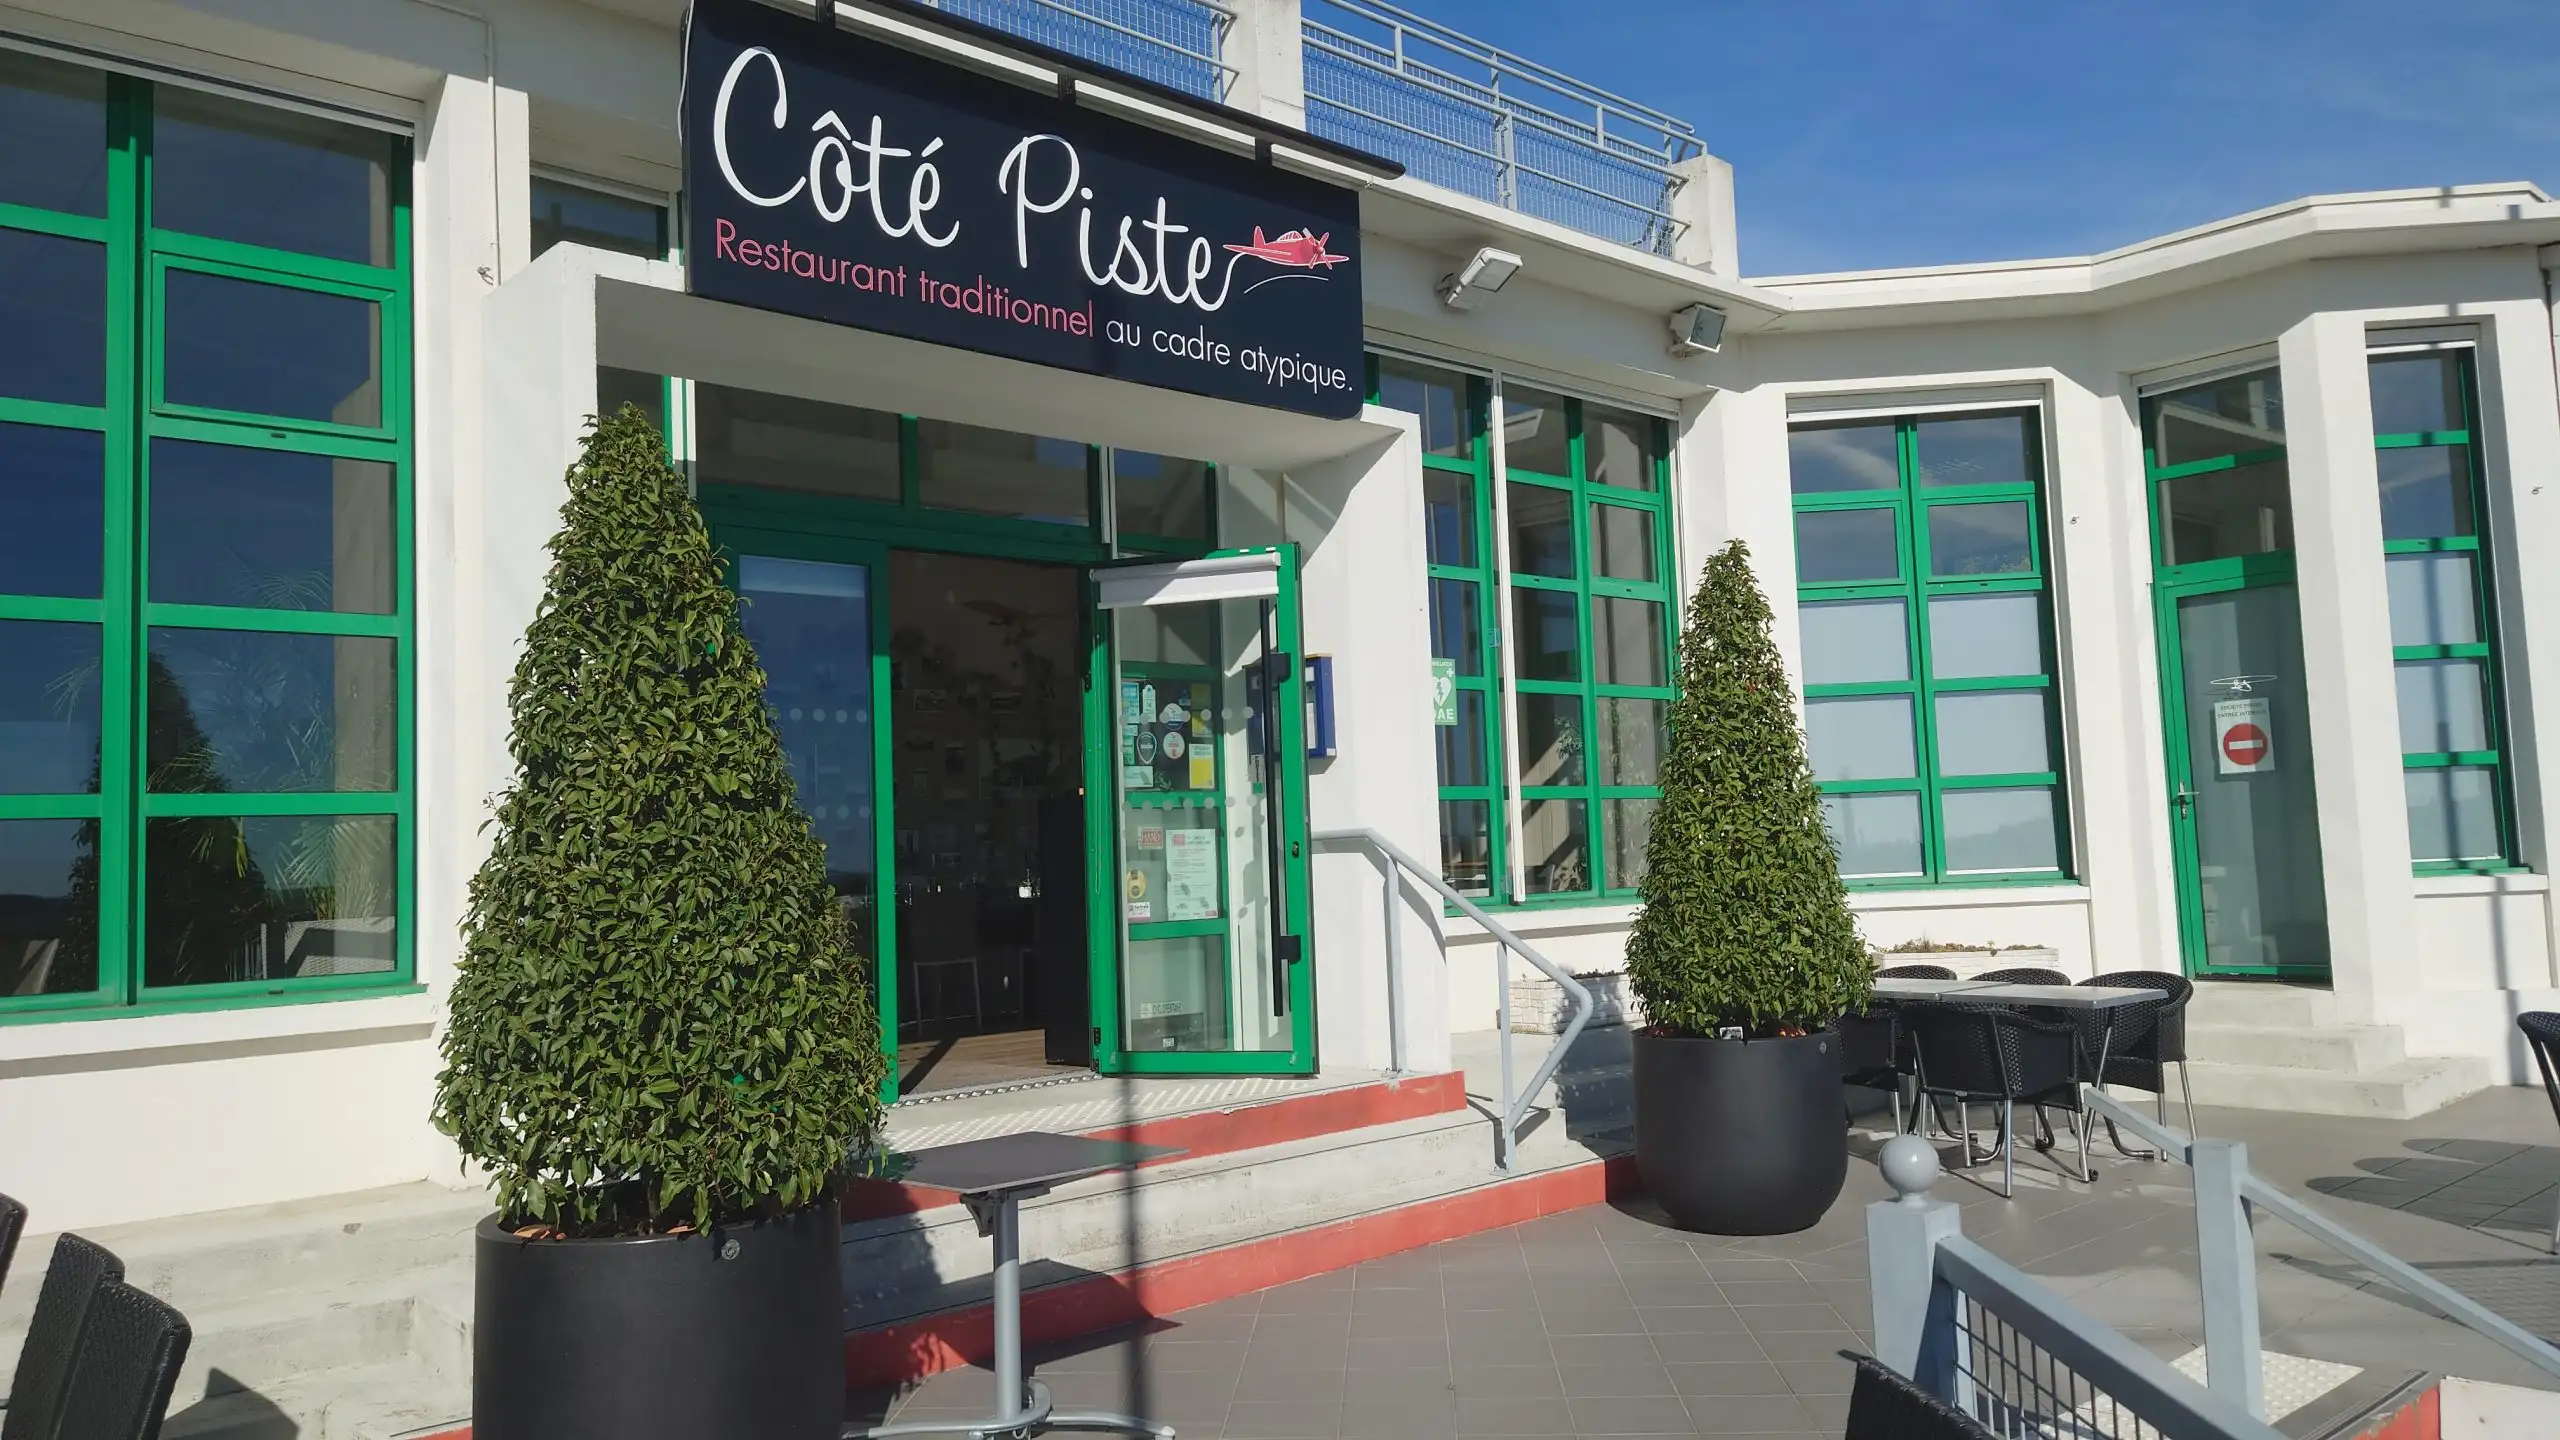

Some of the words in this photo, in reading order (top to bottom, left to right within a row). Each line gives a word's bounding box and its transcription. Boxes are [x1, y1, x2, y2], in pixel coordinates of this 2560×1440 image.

[714, 47, 959, 247] Côté
[999, 135, 1240, 311] Piste
[716, 218, 906, 297] Restaurant
[920, 271, 1094, 337] traditionnel
[1106, 320, 1141, 347] au
[1152, 325, 1231, 365] cadre
[1240, 345, 1354, 394] atypique.
